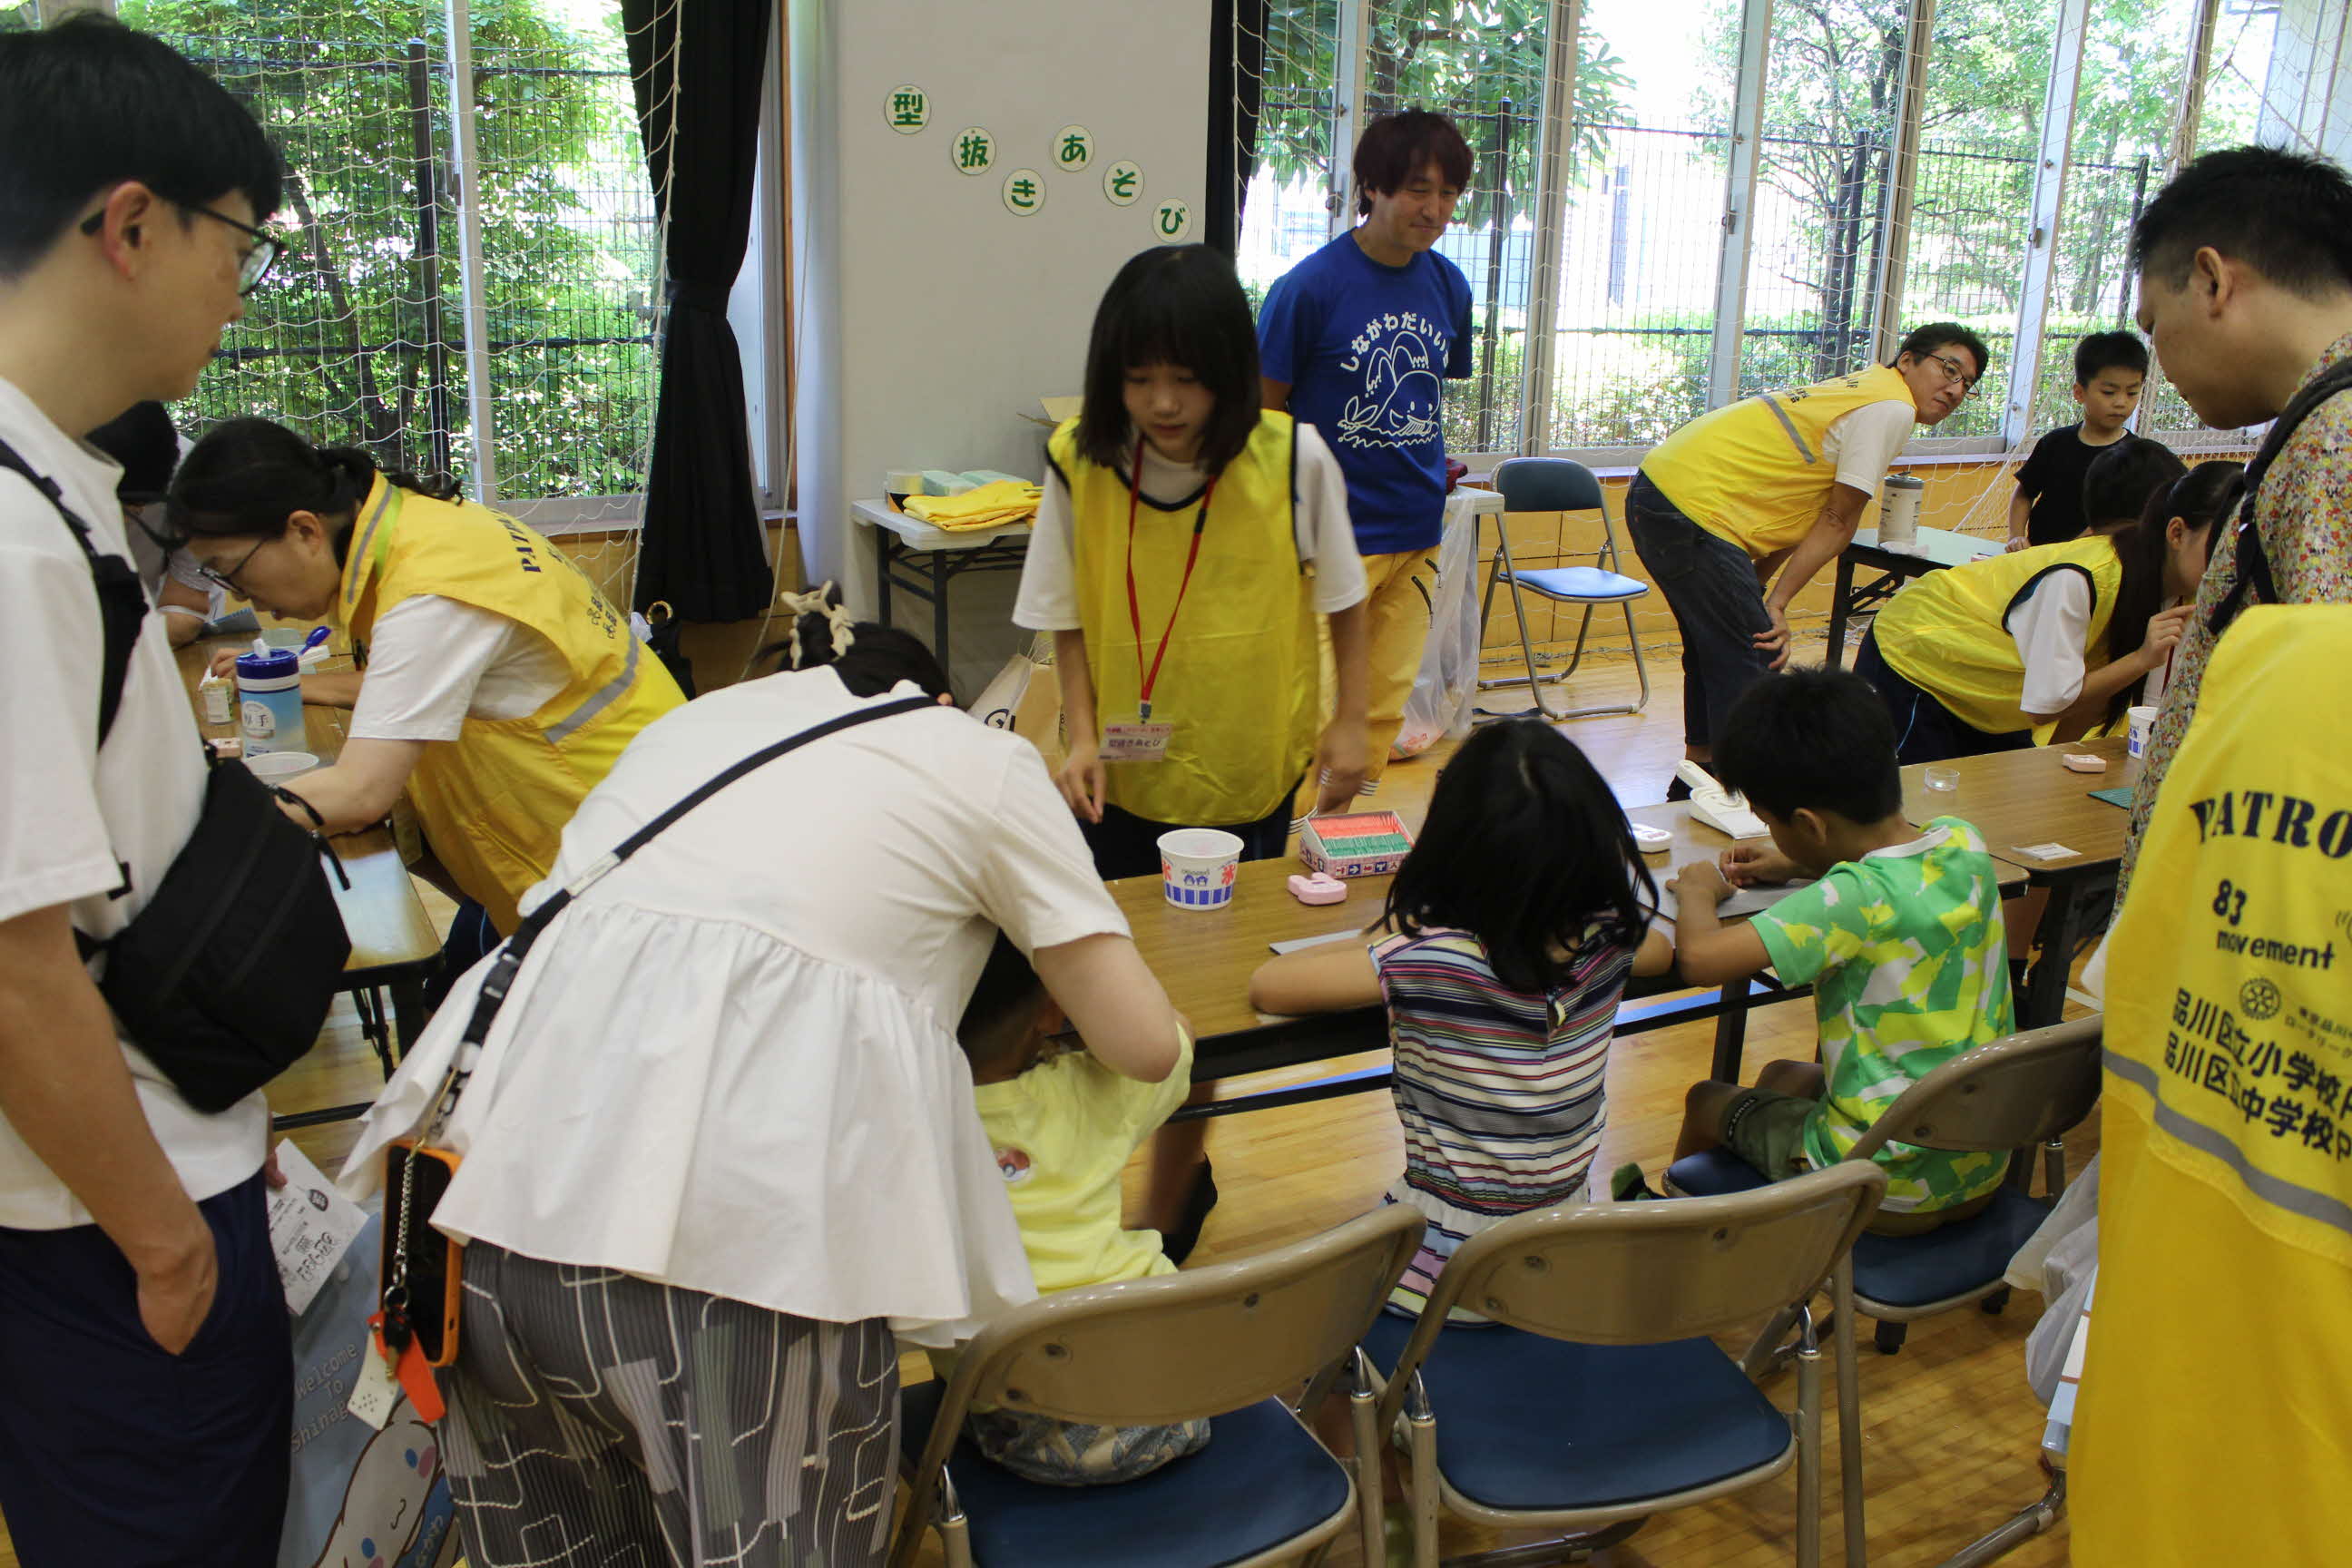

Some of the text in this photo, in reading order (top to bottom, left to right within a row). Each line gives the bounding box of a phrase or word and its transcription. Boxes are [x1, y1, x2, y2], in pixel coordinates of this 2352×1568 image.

[2189, 790, 2352, 859] PATRO
[2212, 877, 2248, 926] 83
[2216, 929, 2336, 970] movement
